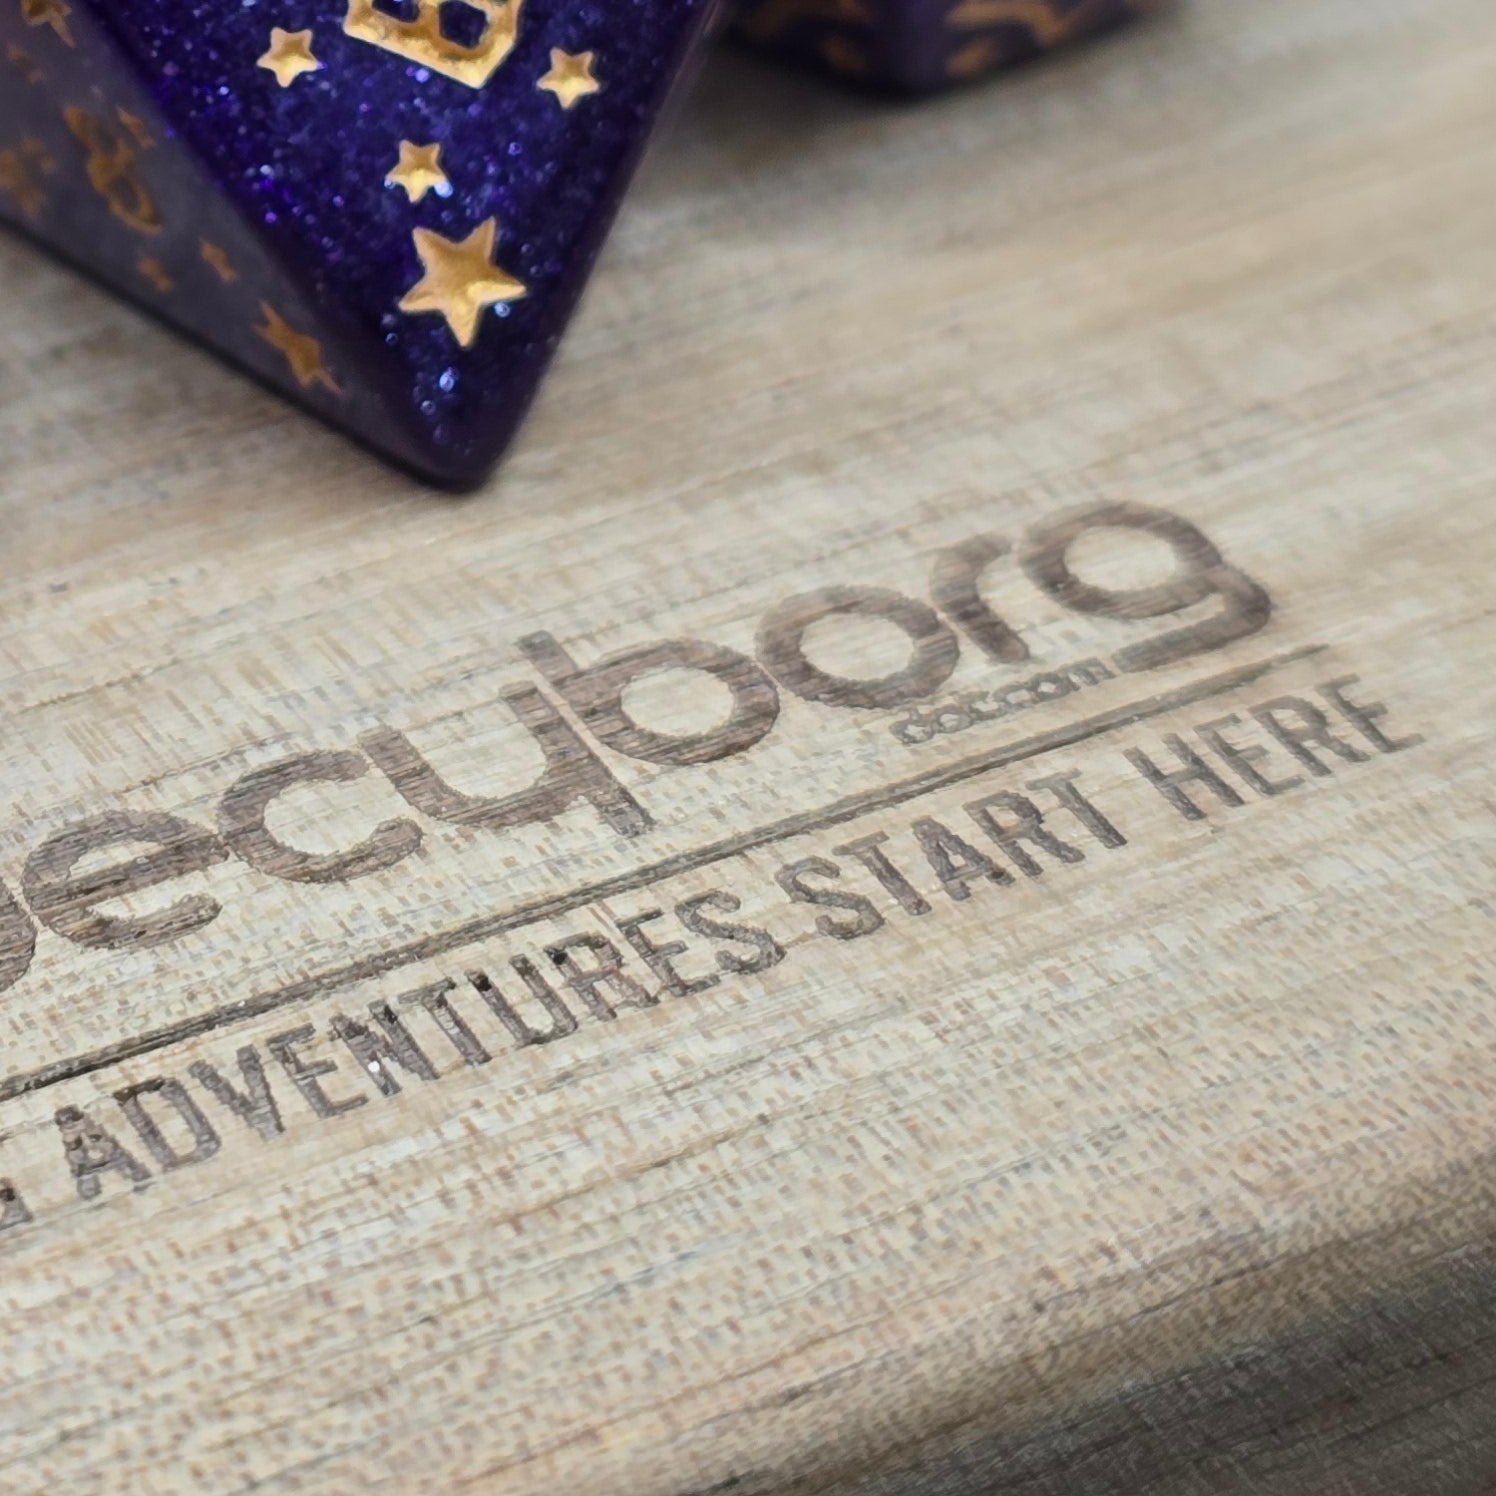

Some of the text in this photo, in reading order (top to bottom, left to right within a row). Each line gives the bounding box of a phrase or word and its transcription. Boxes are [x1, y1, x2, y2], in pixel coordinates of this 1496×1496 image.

[52, 886, 787, 1201] ADVENTURES
[773, 768, 1130, 942] START
[1121, 672, 1425, 821] HERE
